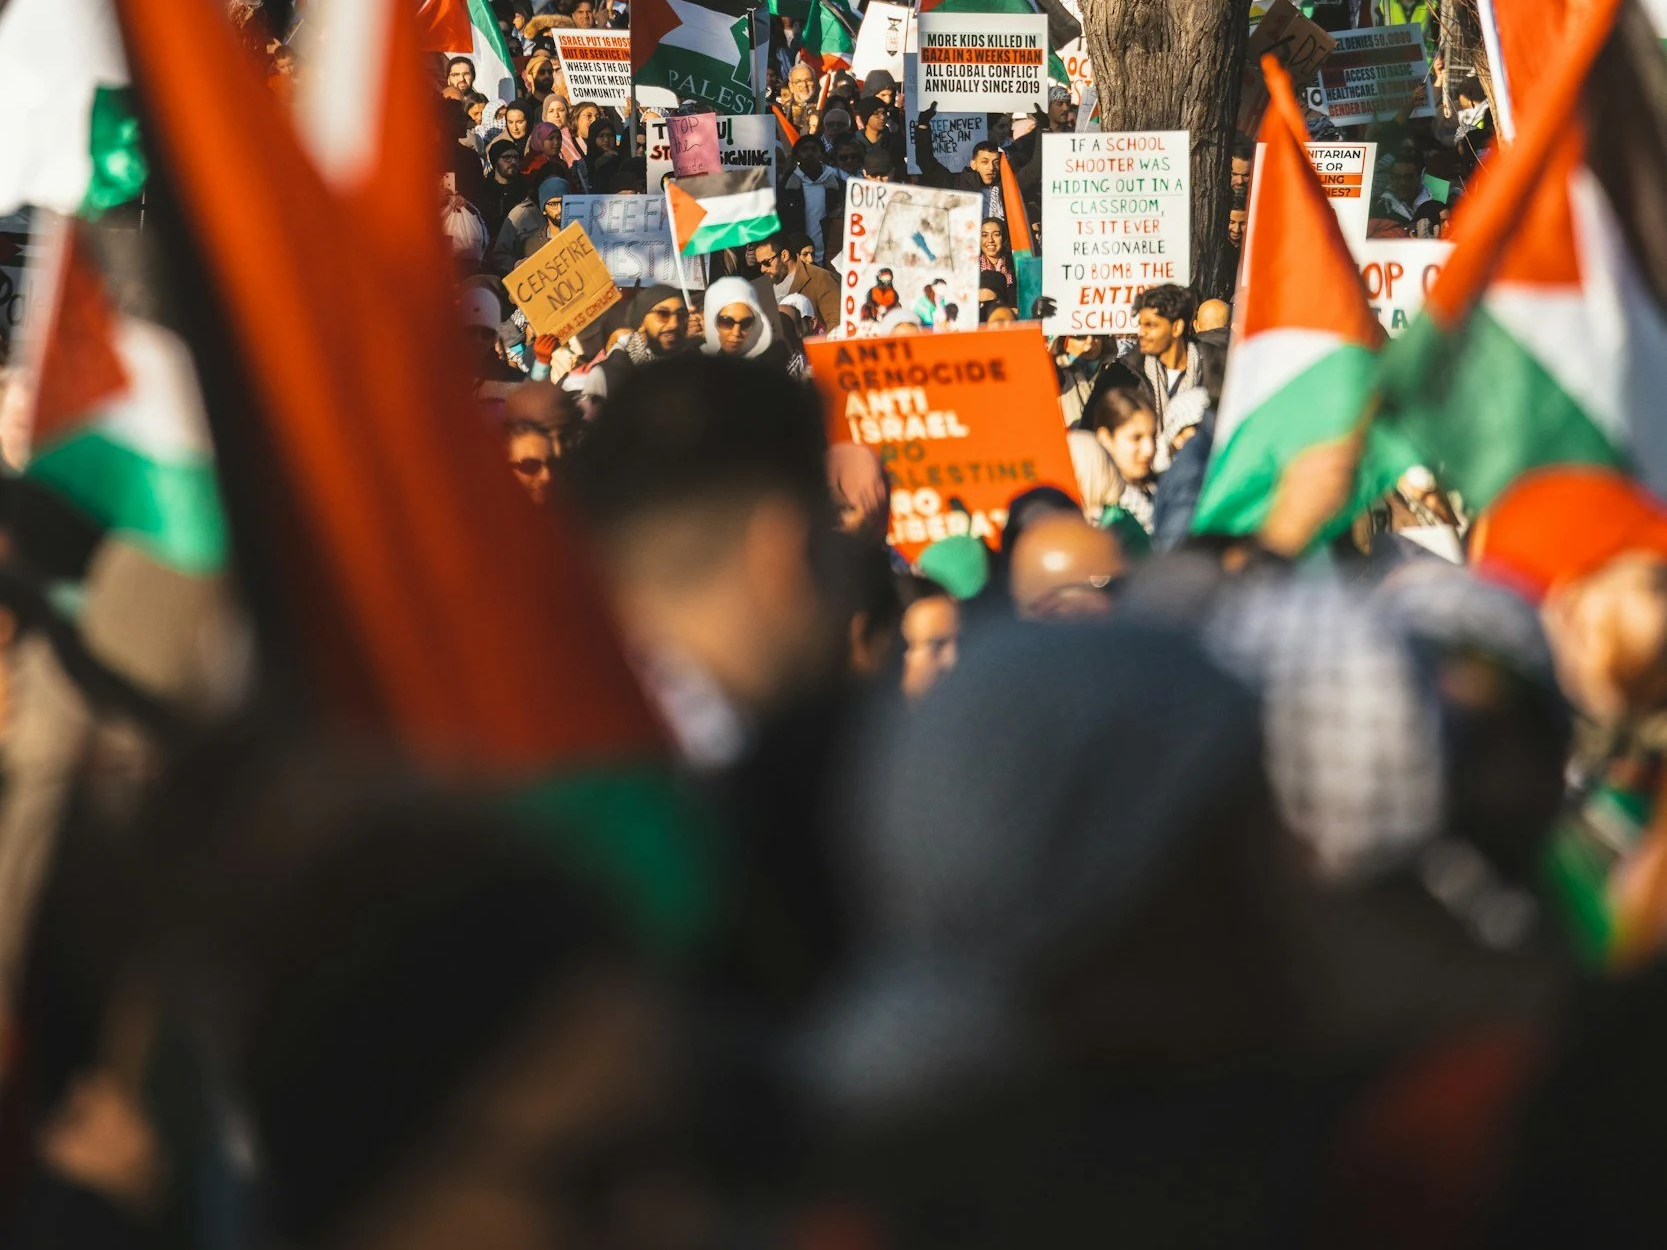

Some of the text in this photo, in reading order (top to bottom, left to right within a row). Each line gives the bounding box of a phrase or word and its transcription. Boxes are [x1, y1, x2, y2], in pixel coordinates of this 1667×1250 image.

[559, 35, 585, 46] ISRAEL
[586, 36, 601, 47] PUT
[602, 37, 611, 47] 16
[927, 33, 1036, 48] MORE KIDS KILLED IN
[562, 49, 578, 59] OUT
[580, 49, 588, 59] OF
[589, 49, 622, 60] SERVICE
[922, 48, 1041, 64] GAZA IN 3 WEEKS THAN
[565, 61, 593, 72] WHERE
[594, 62, 602, 72] IS
[603, 62, 617, 73] THE
[925, 64, 1039, 79] ALL GLOBAL CONFLICT
[1345, 66, 1376, 82] ACCESS
[1376, 65, 1387, 79] TO
[570, 74, 631, 86] FROM THE MEDIC
[925, 79, 1040, 94] ANNUALLY SINCE 2019
[572, 87, 626, 99] COMMUNITY?
[668, 69, 755, 115] PALEST
[1328, 100, 1360, 117] GENDER
[949, 117, 982, 131] NEVER
[957, 130, 971, 142] AN
[932, 141, 958, 154] WNER
[1070, 137, 1165, 153] IF A SCHOOL
[1308, 149, 1361, 159] NITARIAN
[1065, 157, 1170, 174] SHOOTER WAS
[1326, 162, 1343, 171] OR
[1052, 178, 1183, 194] HIDING OUT IN A
[850, 182, 887, 208] OUR
[1070, 198, 1165, 217] CLASSROOM,
[1076, 220, 1160, 235] IS IT EVER
[1073, 240, 1166, 256] REASONABLE
[516, 234, 593, 303] CEASEFIRE
[846, 213, 866, 339] BLOOD
[1062, 262, 1175, 280] TO BOMB THE
[1361, 261, 1404, 300] OP
[547, 271, 584, 311] NOW
[1080, 284, 1153, 305] ENTIR
[1071, 310, 1140, 330] SCHOO
[835, 340, 913, 368] ANTI
[837, 357, 1007, 391] GENOCIDE
[845, 386, 928, 418] ANTI
[849, 409, 970, 445] ISRAEL
[886, 459, 1038, 488] ALESTINE
